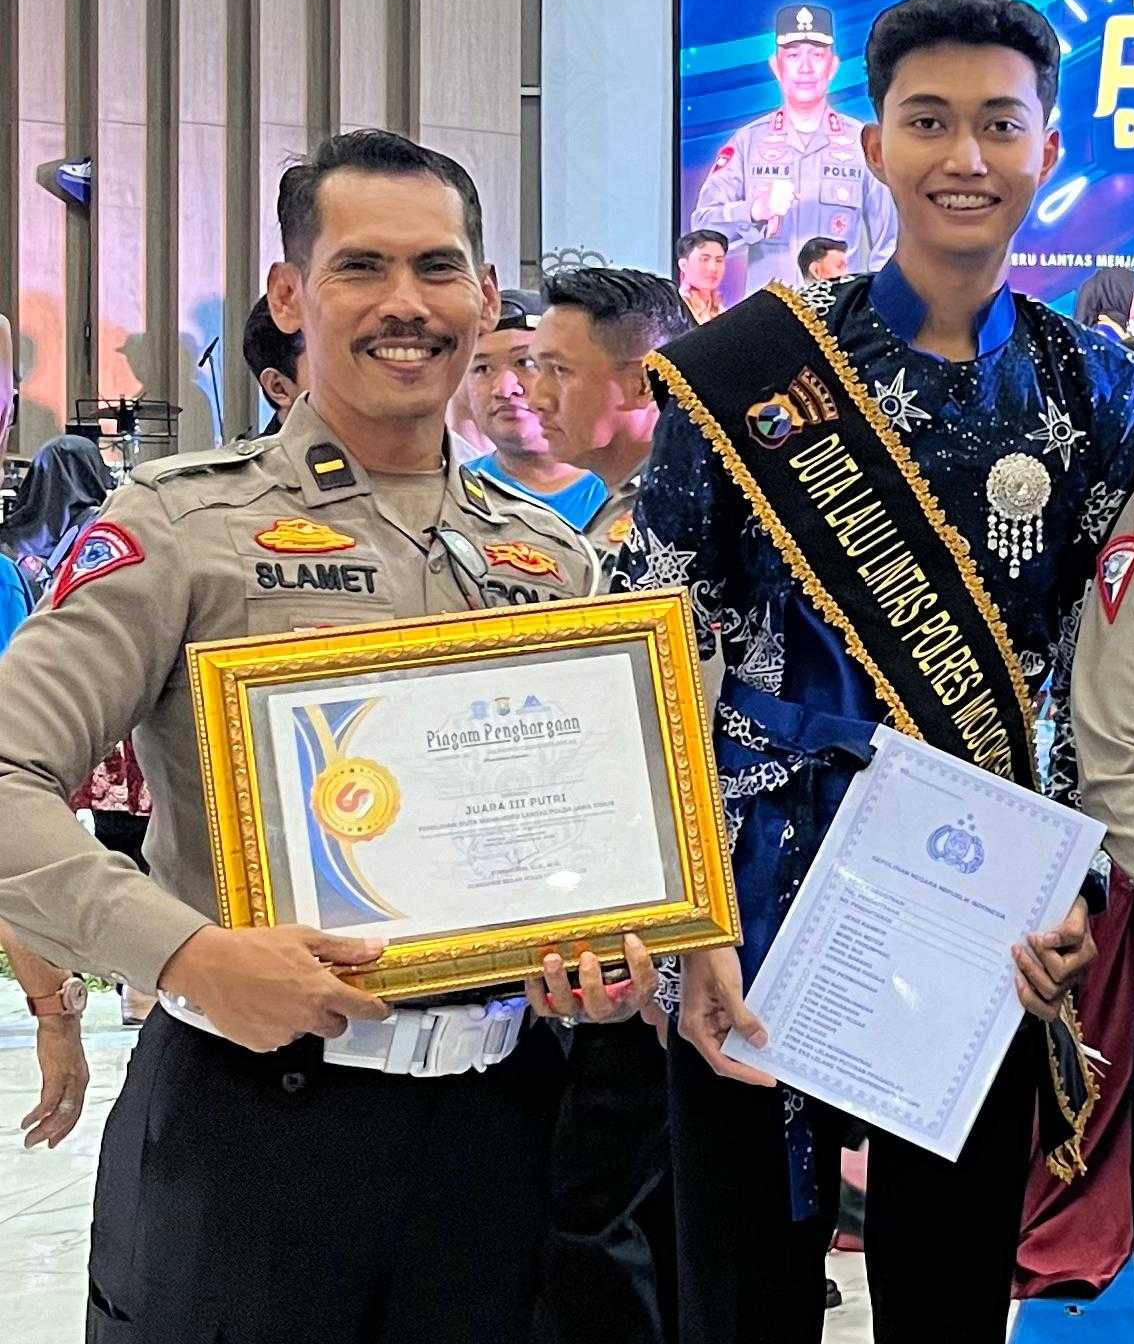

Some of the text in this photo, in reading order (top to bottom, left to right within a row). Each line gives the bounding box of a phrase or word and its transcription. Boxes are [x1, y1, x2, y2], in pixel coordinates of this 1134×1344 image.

[823, 167, 862, 178] POLRI
[1011, 253, 1037, 267] ERU
[1040, 254, 1092, 267] LANTAS
[789, 433, 864, 509] DUTA
[825, 488, 898, 557] LALU
[255, 562, 378, 594] SLAMET
[857, 541, 938, 627] LINTAS
[901, 610, 983, 706] POLRES
[466, 802, 505, 816] JUARA
[530, 793, 567, 806] PUTRI
